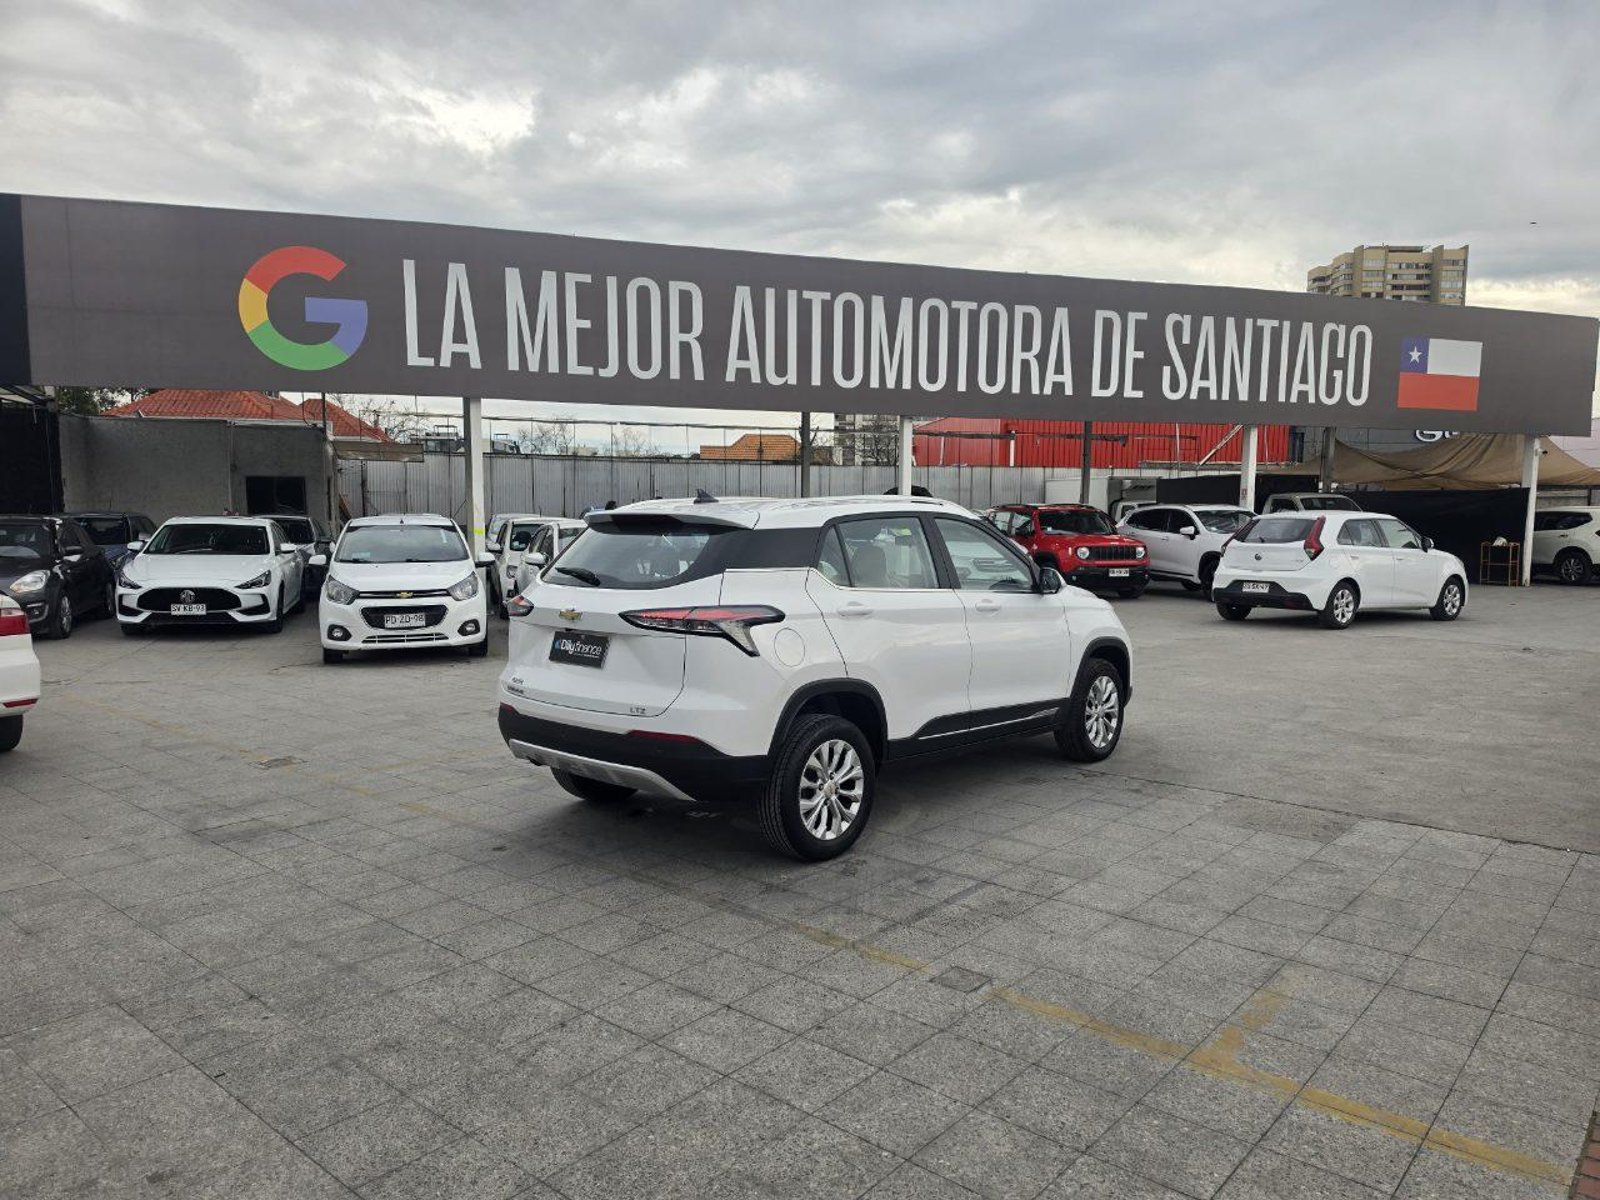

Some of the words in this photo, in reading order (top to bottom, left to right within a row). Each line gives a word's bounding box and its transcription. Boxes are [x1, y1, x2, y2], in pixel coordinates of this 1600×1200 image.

[404, 260, 481, 369] LA
[505, 268, 704, 380] MEJOR
[726, 286, 1073, 396] AUTOMOTORA
[1091, 310, 1147, 398] DE
[1162, 313, 1372, 406] SANTIAGO
